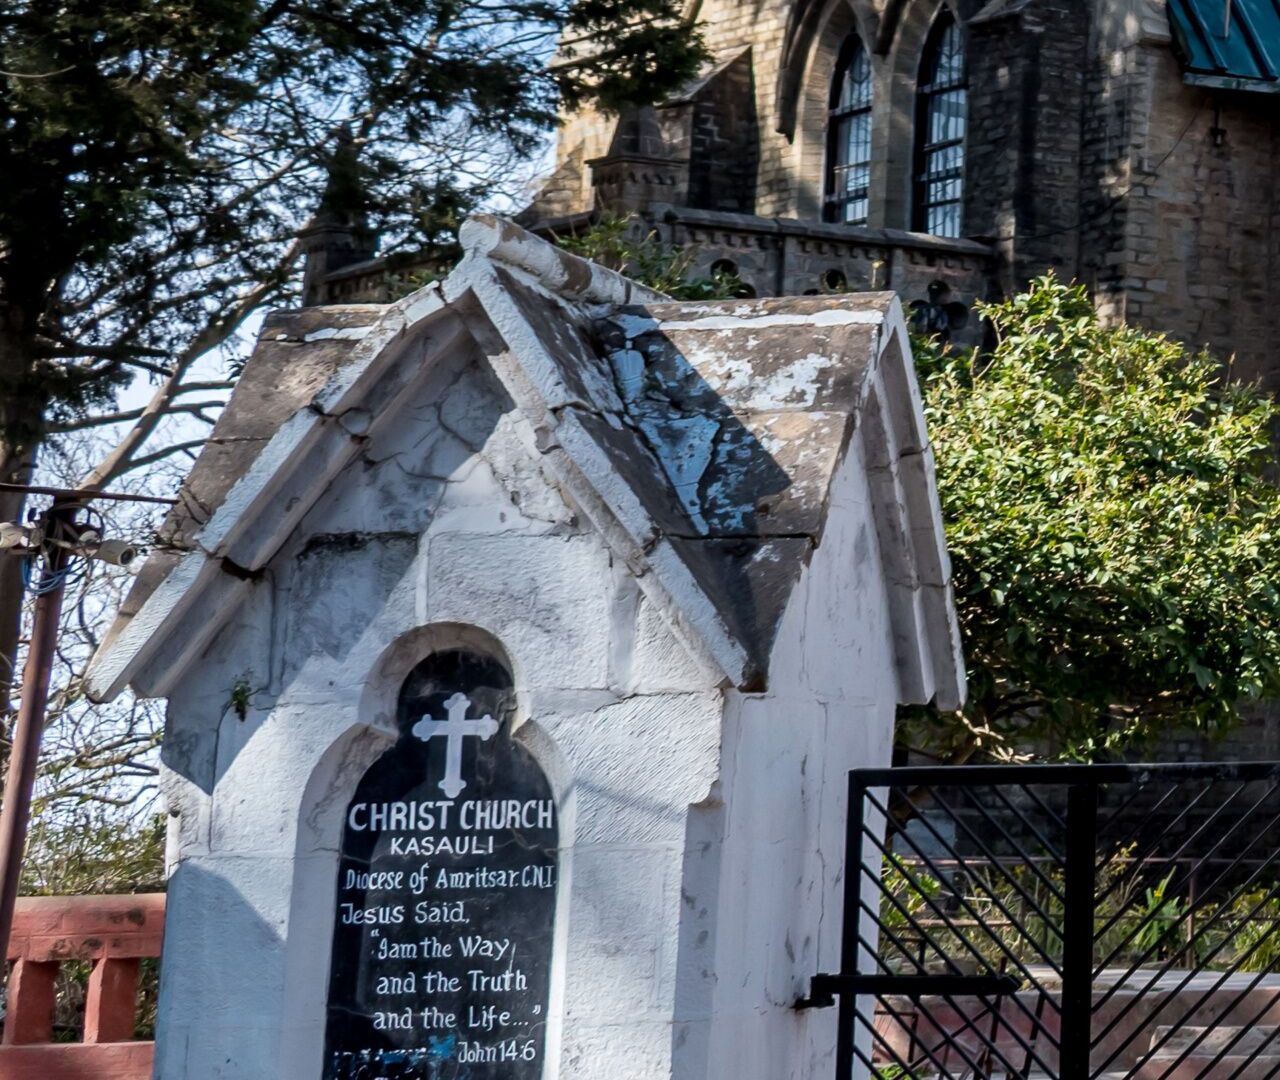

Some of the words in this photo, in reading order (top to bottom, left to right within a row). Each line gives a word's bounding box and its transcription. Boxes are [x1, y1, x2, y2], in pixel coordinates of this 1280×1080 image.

[349, 801, 454, 831] CHRIST
[459, 799, 553, 829] CHURCH
[390, 835, 494, 856] KASAULI
[346, 869, 403, 890] Diocese
[409, 862, 430, 895] of
[340, 902, 405, 924] Jesus
[414, 900, 470, 924] Said,
[419, 936, 452, 958] the
[376, 972, 417, 995] and
[422, 971, 462, 993] the
[467, 969, 528, 992] Truth
[372, 1007, 413, 1030] and
[419, 1006, 456, 1029] the
[457, 1040, 497, 1063] John
[498, 1039, 536, 1062] 14:6
